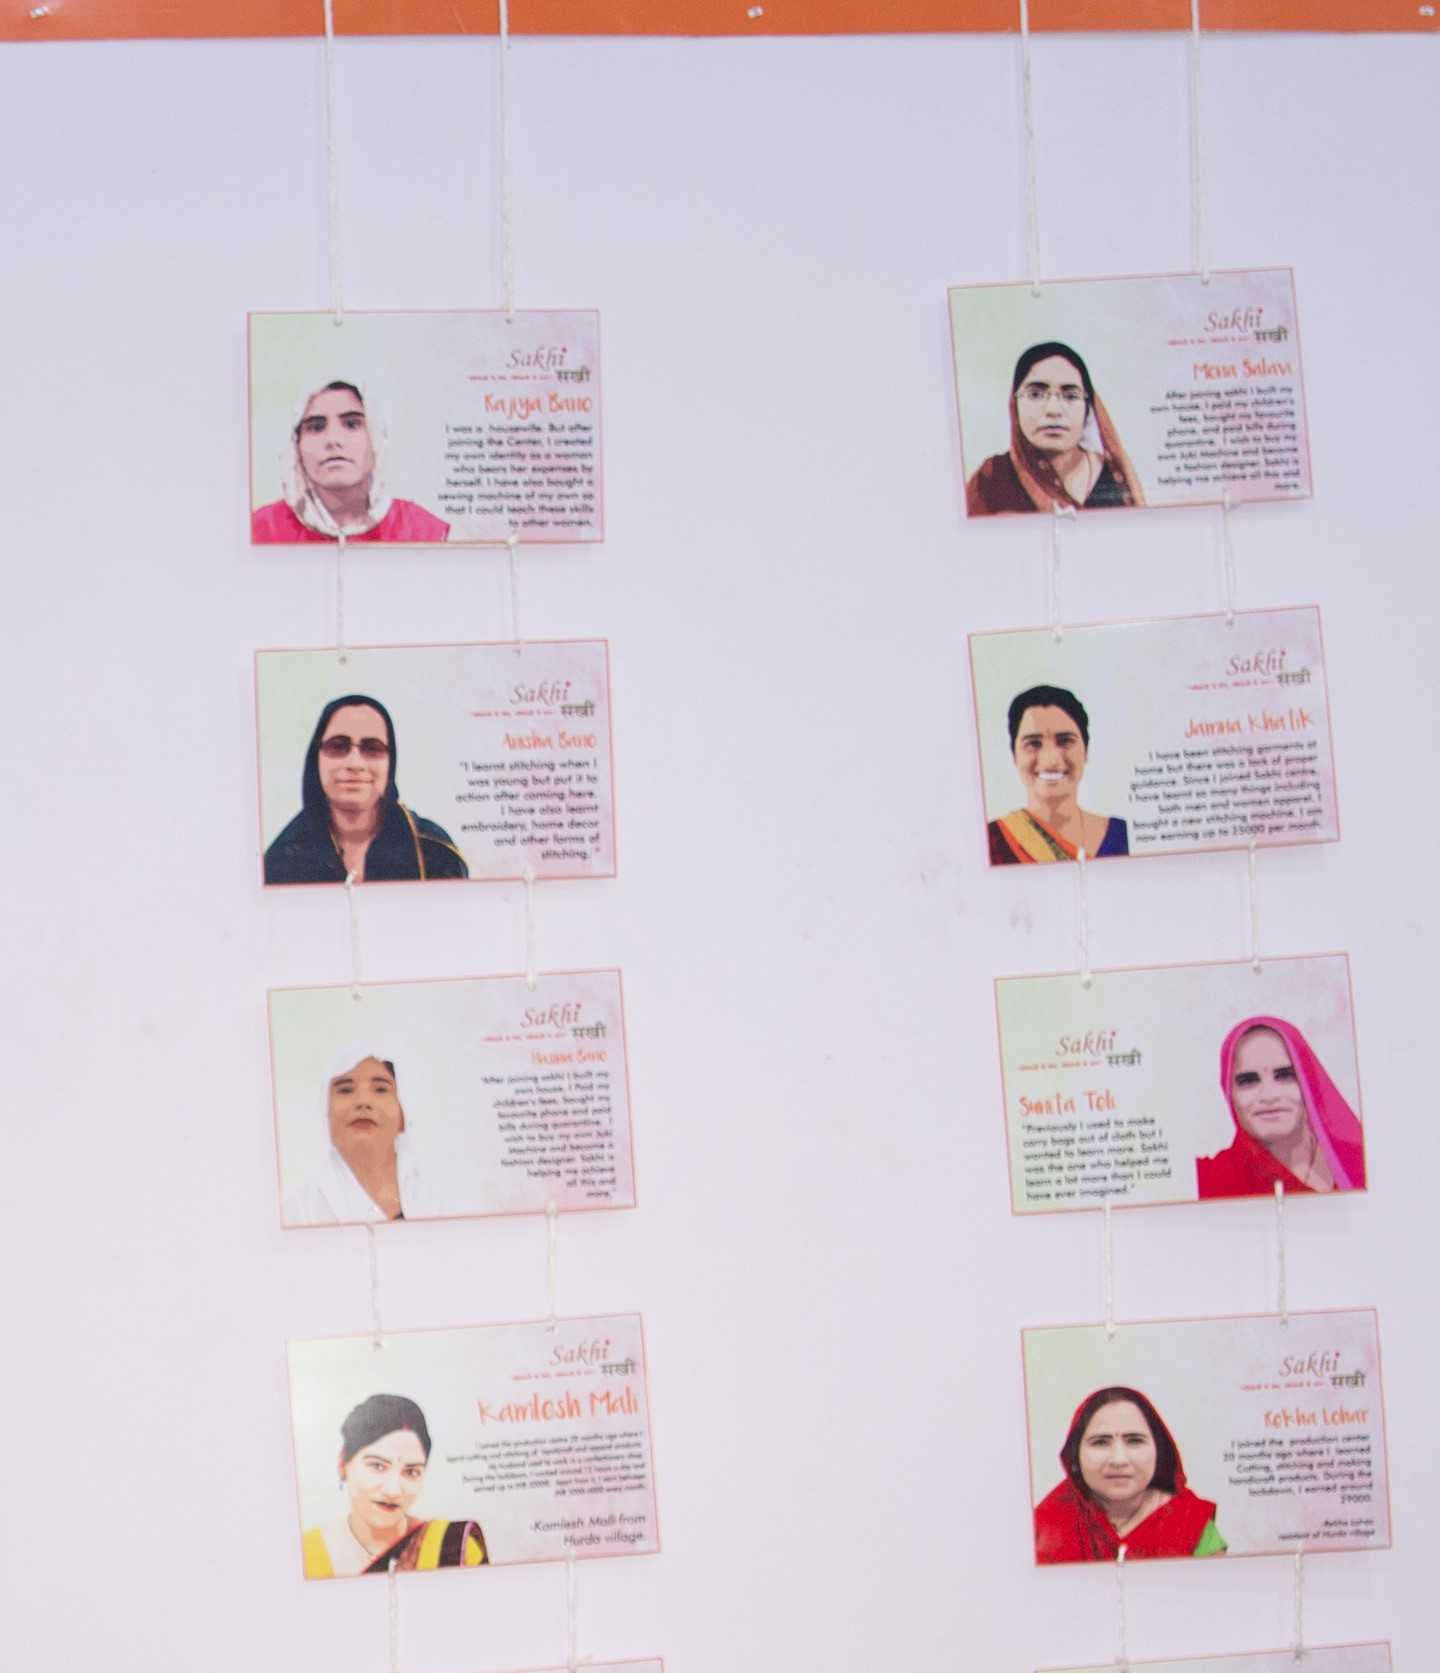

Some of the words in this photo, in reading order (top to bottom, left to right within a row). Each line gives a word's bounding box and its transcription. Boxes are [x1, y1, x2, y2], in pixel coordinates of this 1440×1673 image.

[1204, 308, 1264, 333] Sakhi
[506, 347, 567, 371] Sakhi
[548, 392, 592, 412] Bano
[1226, 650, 1286, 677] Sakhi
[509, 681, 571, 706] Sakhi
[558, 730, 596, 749] Bano
[509, 758, 555, 773] stitching
[559, 758, 590, 770] when
[468, 777, 489, 787] was
[494, 776, 528, 789] young
[532, 774, 550, 785] but
[554, 774, 573, 786] put
[575, 773, 582, 783] it
[587, 774, 598, 783] to
[455, 791, 490, 802] action
[494, 790, 520, 801] after
[524, 789, 564, 801] coming
[520, 1003, 582, 1029] Sakhi
[1056, 1030, 1118, 1058] Sakhi
[549, 1339, 610, 1367] Sakhi
[1279, 1352, 1341, 1378] Sakhi
[478, 1391, 581, 1424] Kamlesh
[590, 1385, 640, 1417] Mali
